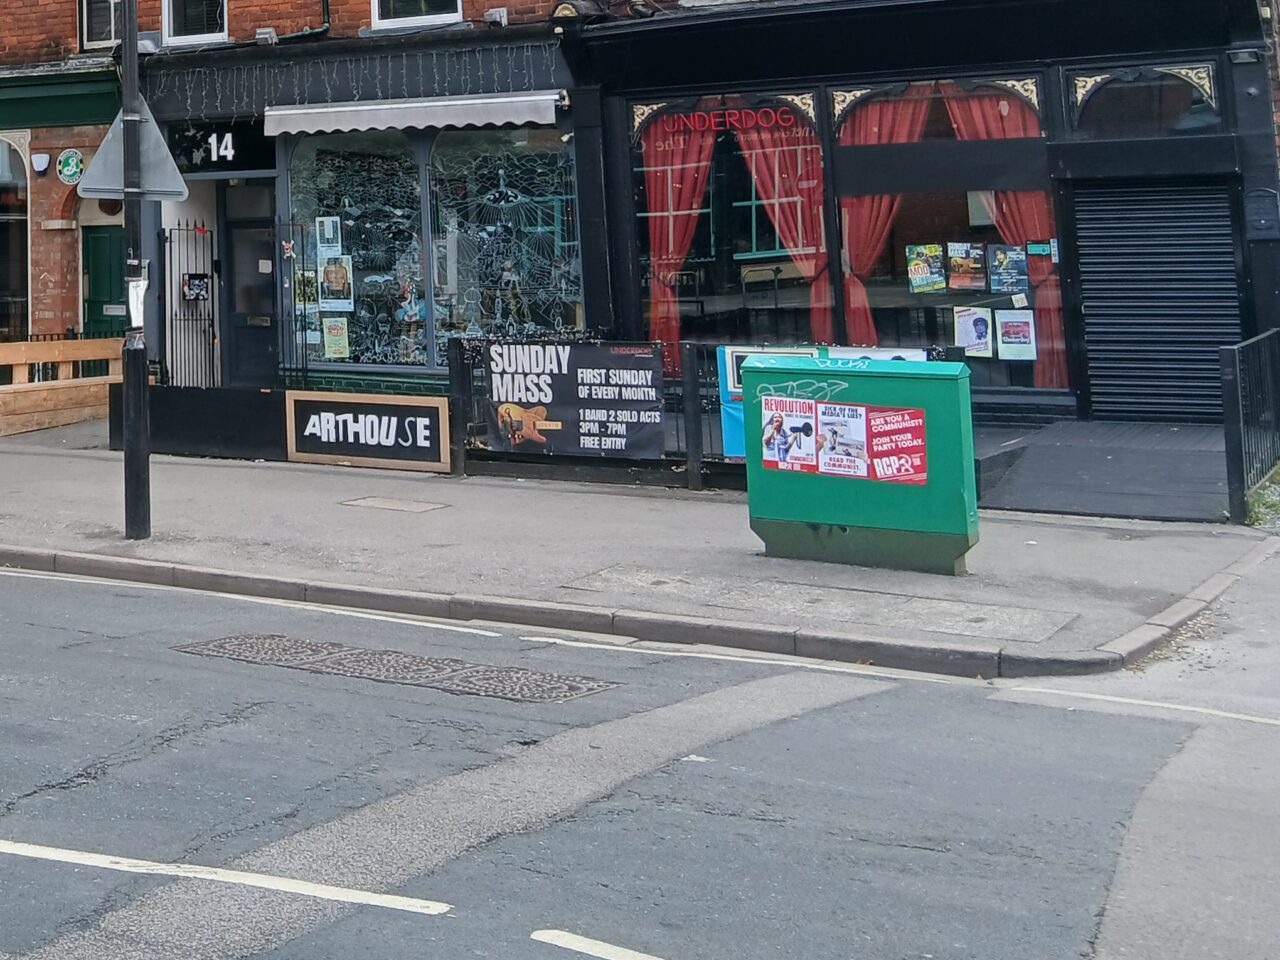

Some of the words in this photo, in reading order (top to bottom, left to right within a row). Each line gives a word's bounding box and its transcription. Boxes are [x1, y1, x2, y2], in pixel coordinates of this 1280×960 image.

[663, 107, 795, 133] UNDERDOG
[207, 132, 235, 162] 14
[909, 265, 929, 278] MOD
[490, 344, 571, 375] SUNDAY
[577, 368, 607, 384] FIRST
[609, 370, 653, 386] SUNDAY
[492, 374, 553, 404] MASS
[578, 387, 591, 399] OF
[592, 387, 621, 400] EVERY
[622, 387, 656, 401] MONTH
[764, 398, 814, 415] REVOLUTION
[579, 409, 584, 421] 1
[585, 409, 607, 421] BAND
[609, 410, 616, 421] 2
[617, 411, 638, 422] SOLO
[640, 411, 661, 423] ACTS
[870, 417, 885, 426] ARE
[885, 415, 902, 423] YOU
[904, 413, 910, 421] A
[303, 412, 431, 448] ARTHOUSE
[579, 422, 600, 434] 3PM
[607, 423, 627, 435] 7PM
[871, 419, 923, 433] COMMUNIST?
[580, 437, 600, 449] FREE
[601, 437, 627, 450] ENTRY
[872, 436, 890, 445] JOIN
[891, 433, 912, 442] YOUR
[873, 442, 896, 452] PARTY
[897, 438, 925, 448] TODAY.
[873, 456, 899, 478] RCP
